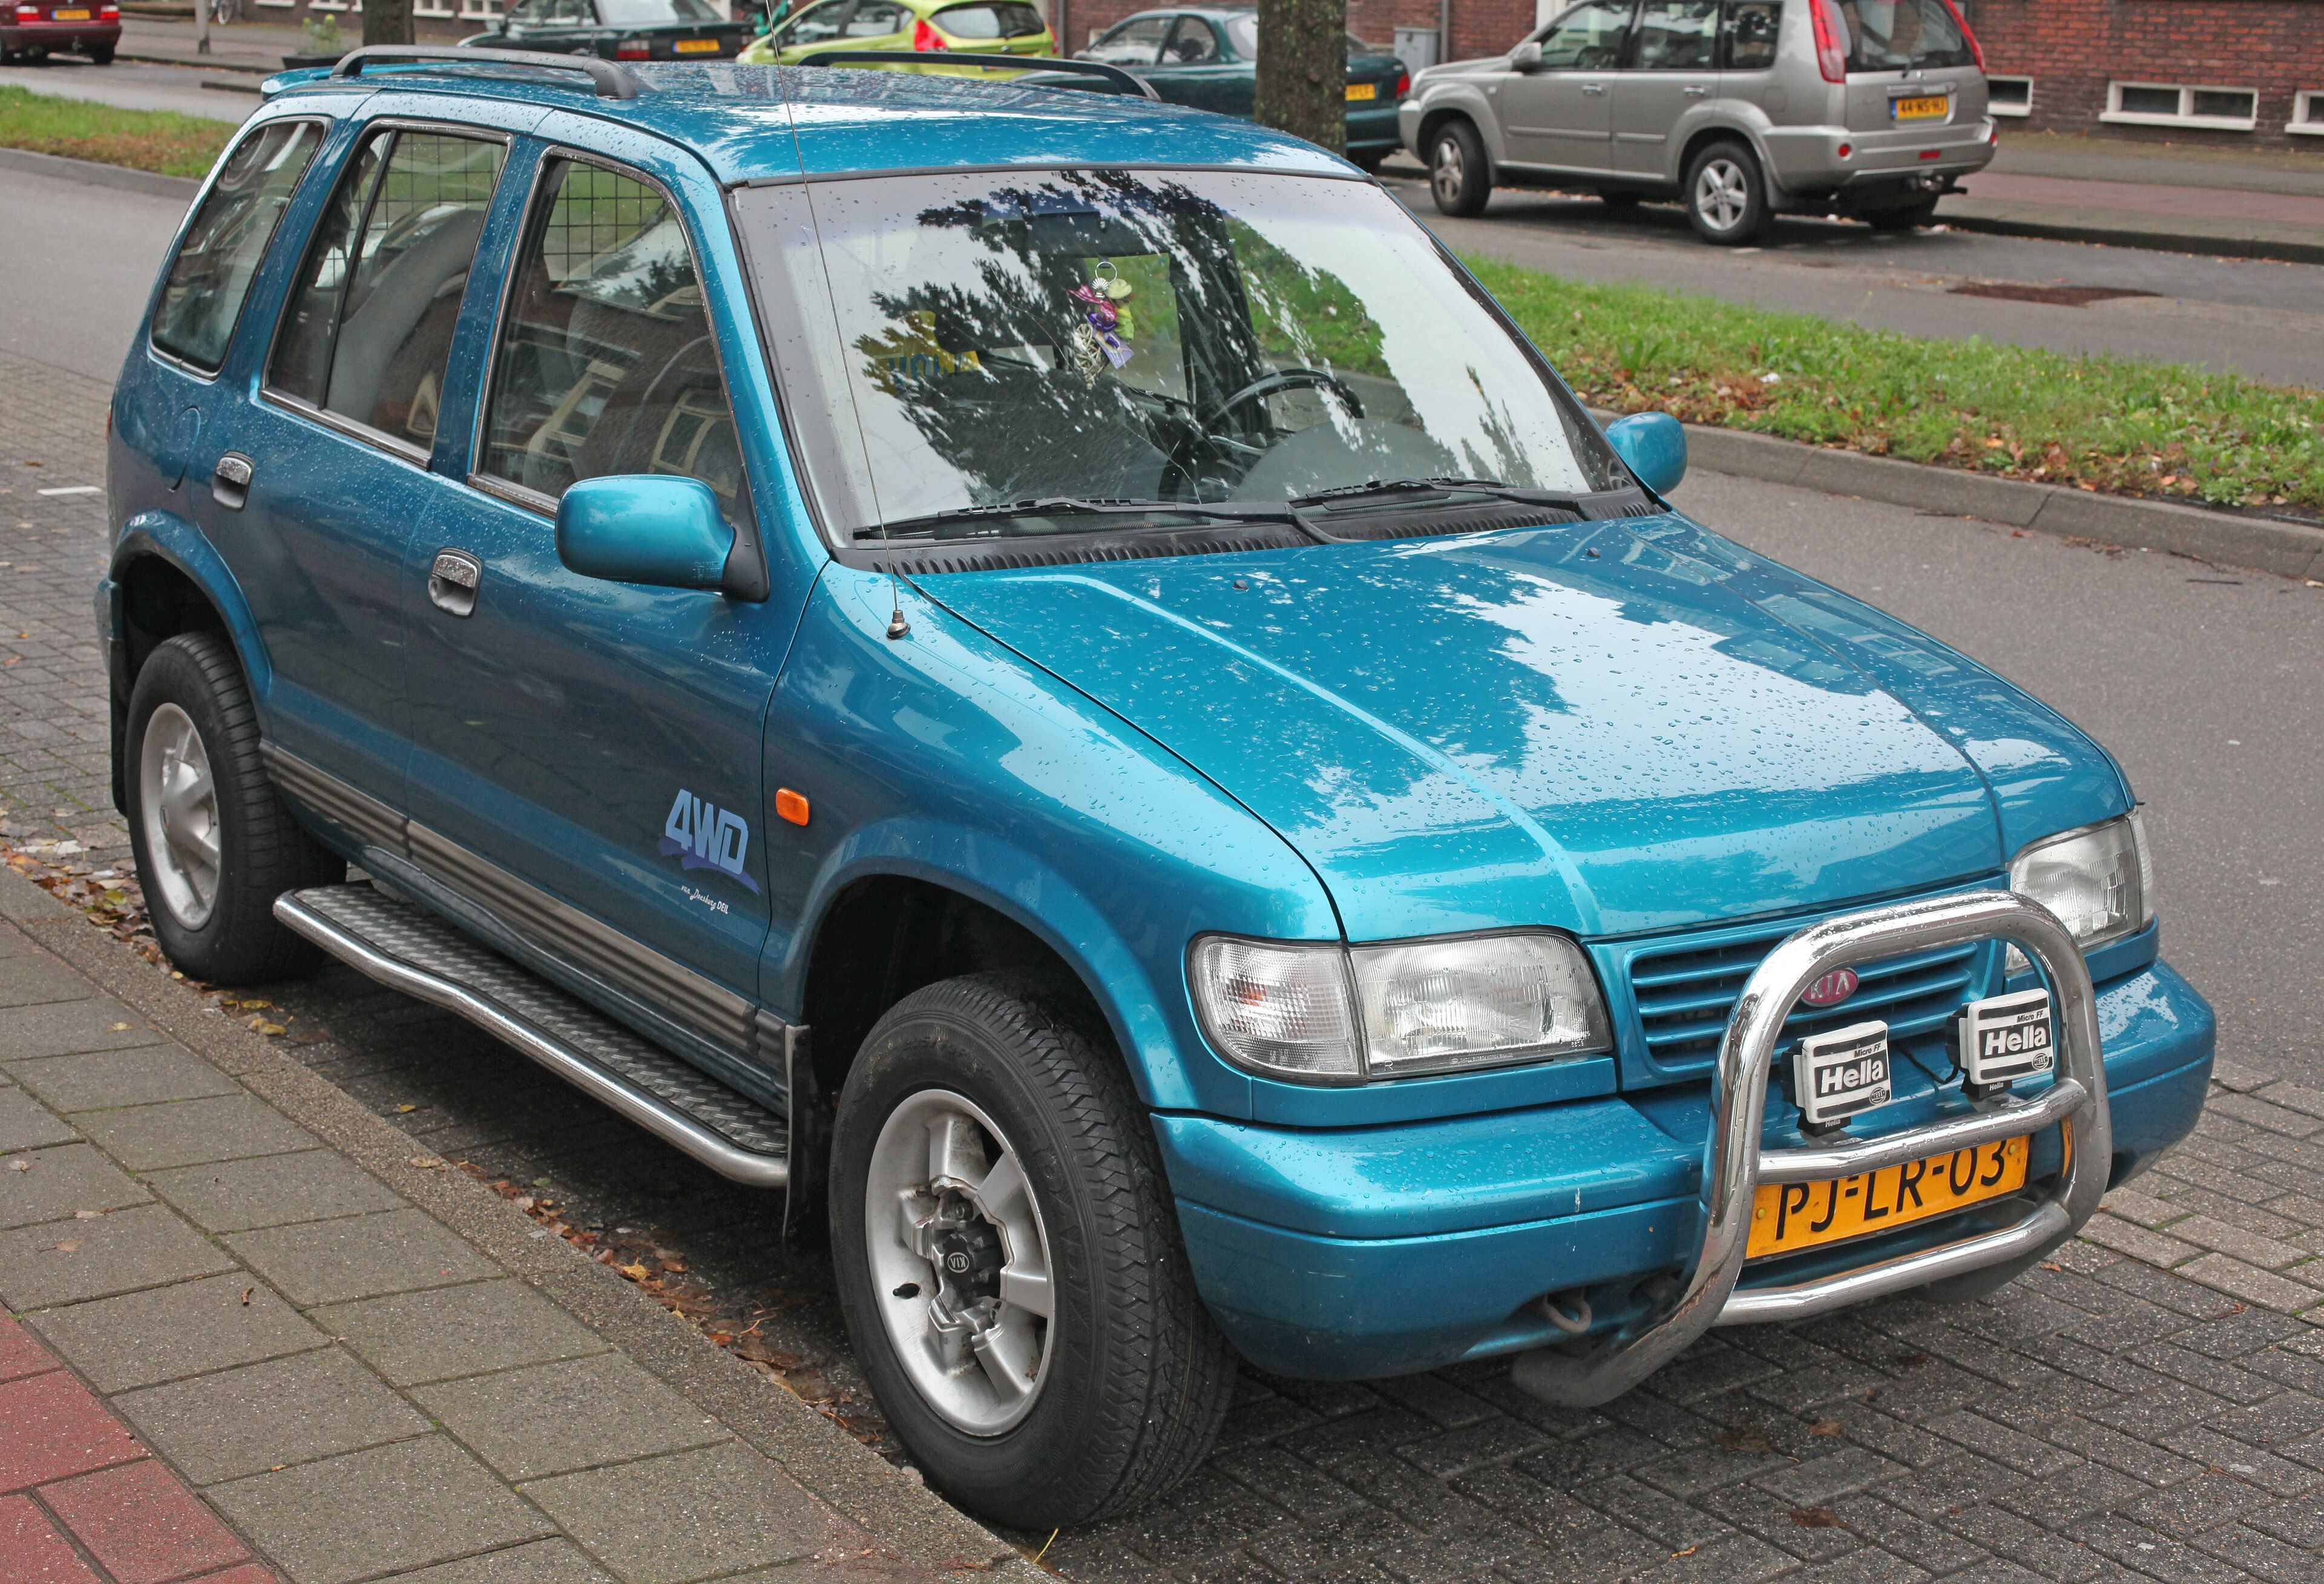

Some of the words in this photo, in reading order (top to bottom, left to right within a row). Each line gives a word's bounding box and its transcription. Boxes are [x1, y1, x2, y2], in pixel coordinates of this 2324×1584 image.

[666, 789, 748, 874] 4WD
[1811, 972, 1850, 999] KIA
[2017, 1014, 2034, 1023] Micro
[2037, 1010, 2043, 1019] FF
[1984, 1024, 2047, 1056] Hella
[1854, 1048, 1872, 1058] Micro
[1874, 1043, 1882, 1053] FF
[2034, 1056, 2048, 1065] HELLA
[1820, 1059, 1884, 1094] Hella
[1989, 1082, 2004, 1091] Hella
[1871, 1090, 1886, 1099] HELLA
[1825, 1118, 1841, 1128] Hella
[1775, 1140, 2007, 1240] PJ-LR-03
[950, 1257, 966, 1268] KIA
